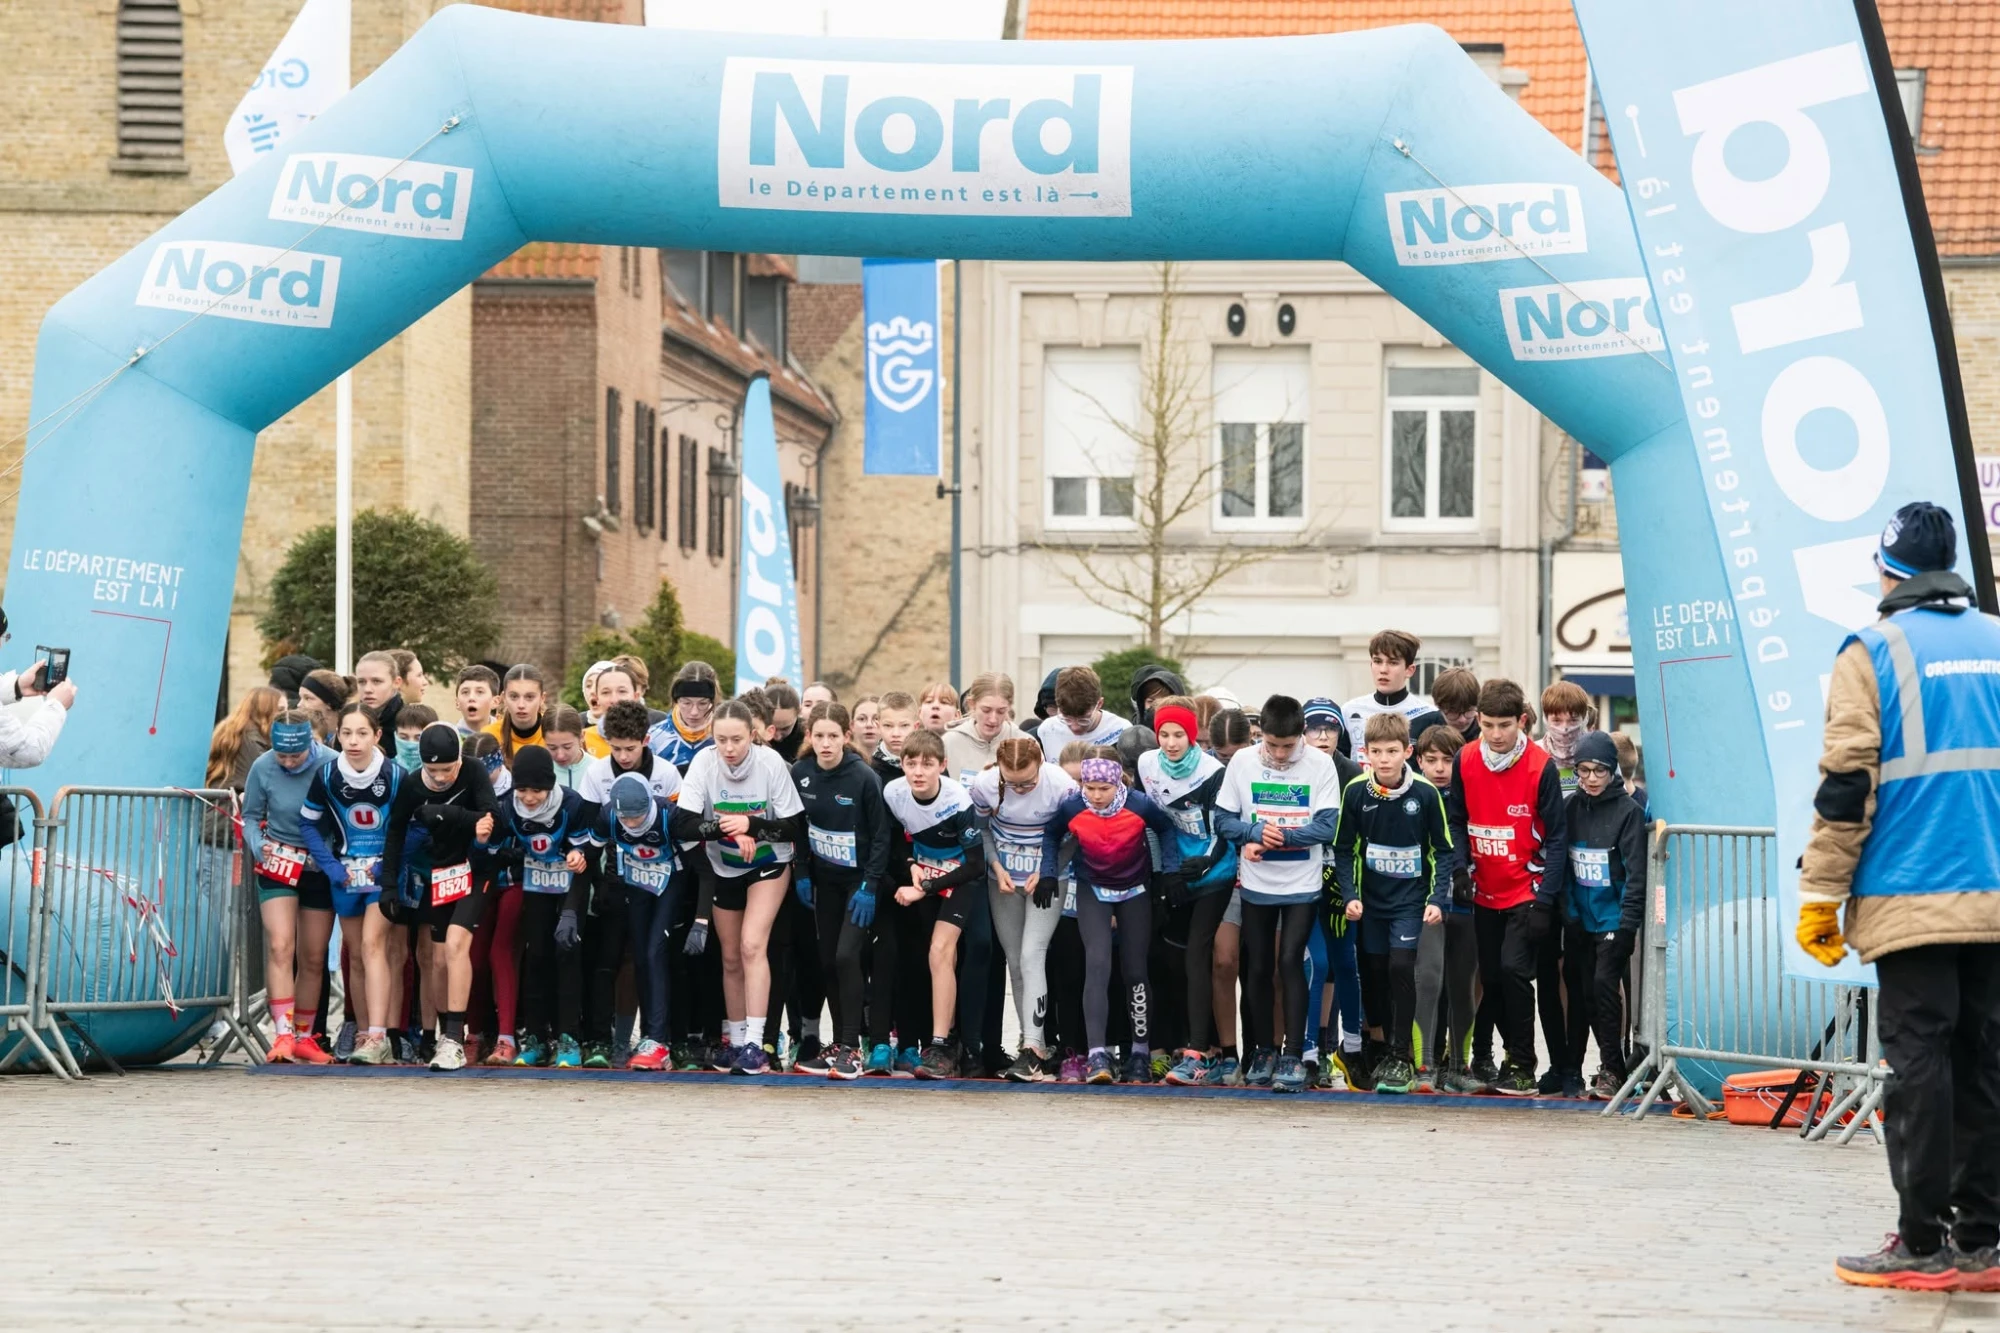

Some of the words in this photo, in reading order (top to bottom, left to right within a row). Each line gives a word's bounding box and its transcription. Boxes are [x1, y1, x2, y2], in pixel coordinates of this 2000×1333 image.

[749, 71, 1102, 175] Nord
[287, 160, 458, 221] Nord
[749, 177, 772, 195] le
[787, 179, 969, 203] Département
[982, 186, 1022, 203] est
[1036, 185, 1060, 203] là
[282, 205, 295, 214] le
[394, 221, 414, 231] est
[1400, 188, 1571, 246] Nord
[1408, 251, 1419, 260] le
[1424, 243, 1509, 260] Département
[1515, 241, 1535, 251] est
[155, 248, 325, 308] Nord
[261, 308, 281, 318] est
[1523, 346, 1533, 355] le
[1540, 339, 1625, 355] Département
[24, 550, 42, 570] LE
[45, 550, 185, 588] DÉPARTEMENT
[93, 579, 132, 603] EST
[139, 585, 164, 608] LÀ
[740, 472, 786, 697] ord
[1653, 604, 1671, 627] LE
[1680, 600, 1735, 624] DÉPA
[1656, 628, 1684, 651] EST
[1693, 623, 1718, 647] LÀ
[355, 811, 374, 825] U
[532, 839, 548, 851] U
[815, 840, 851, 861] 8003
[1475, 837, 1509, 857] 8515
[1005, 854, 1042, 873] 8007
[1374, 859, 1416, 874] 8023
[438, 874, 469, 898] 8520
[531, 870, 569, 888] 8040
[631, 867, 665, 889] 8037
[1131, 983, 1147, 1037] adidas
